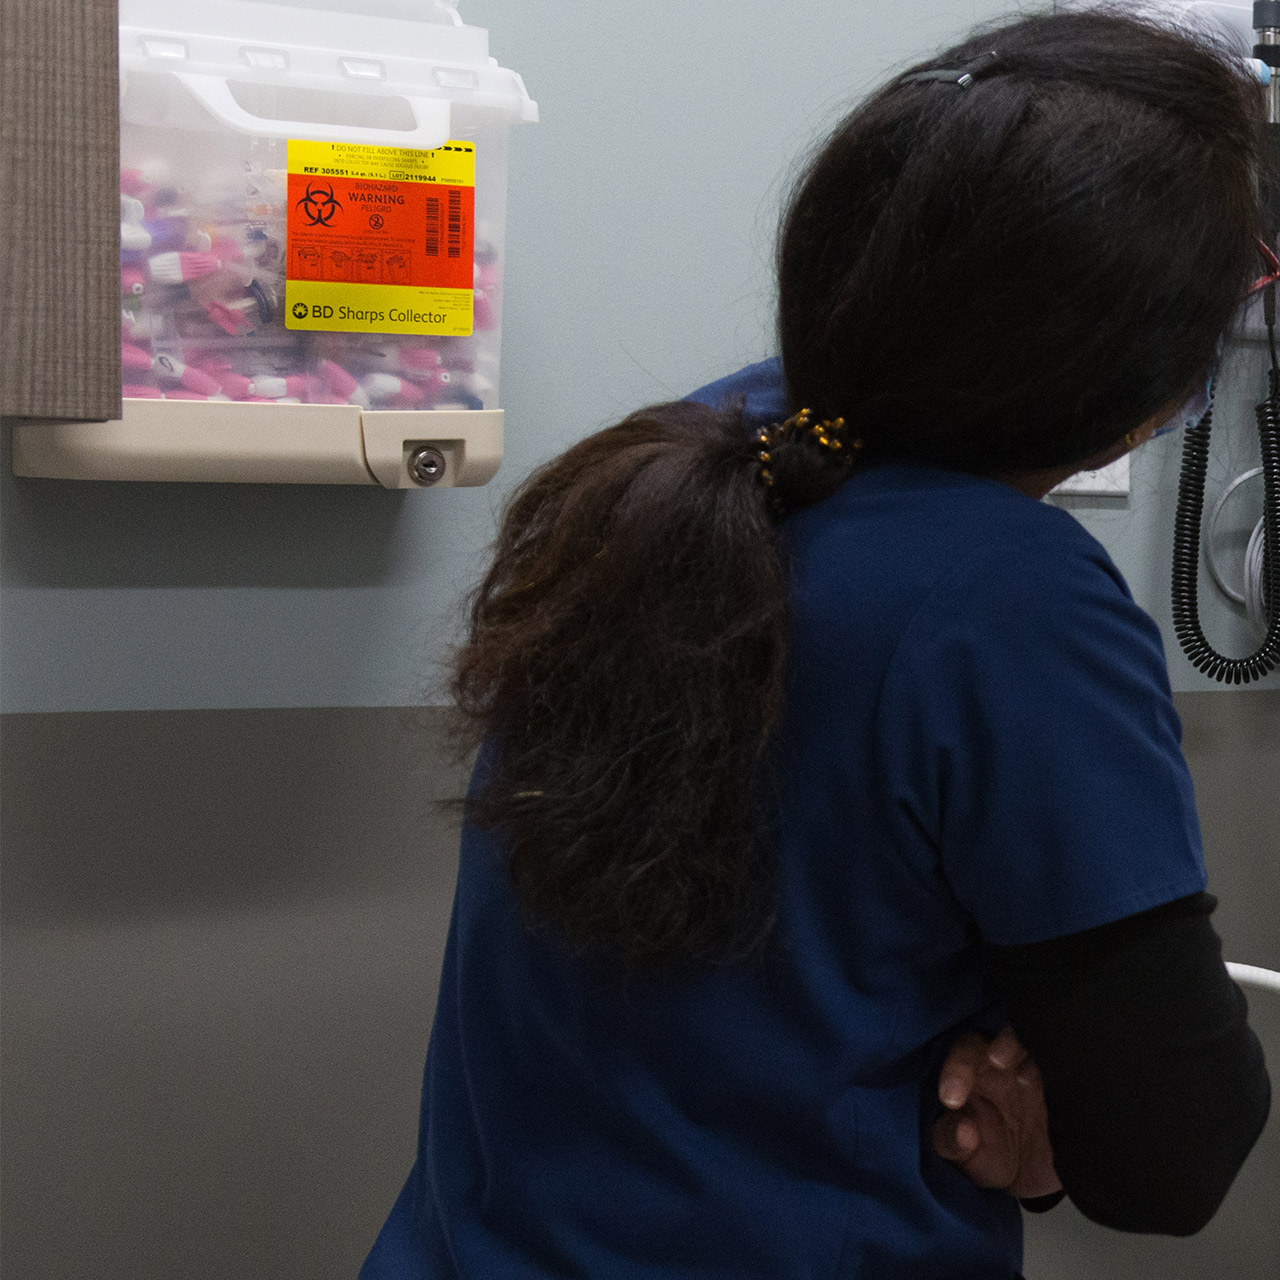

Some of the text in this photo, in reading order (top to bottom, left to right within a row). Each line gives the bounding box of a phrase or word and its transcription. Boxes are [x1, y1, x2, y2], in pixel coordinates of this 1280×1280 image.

[405, 174, 436, 182] 2119944
[355, 182, 398, 192] BIOHAZARD
[348, 192, 405, 205] WARNING
[361, 204, 392, 213] PELIGRO
[312, 305, 447, 324] BD Sharps Collector
